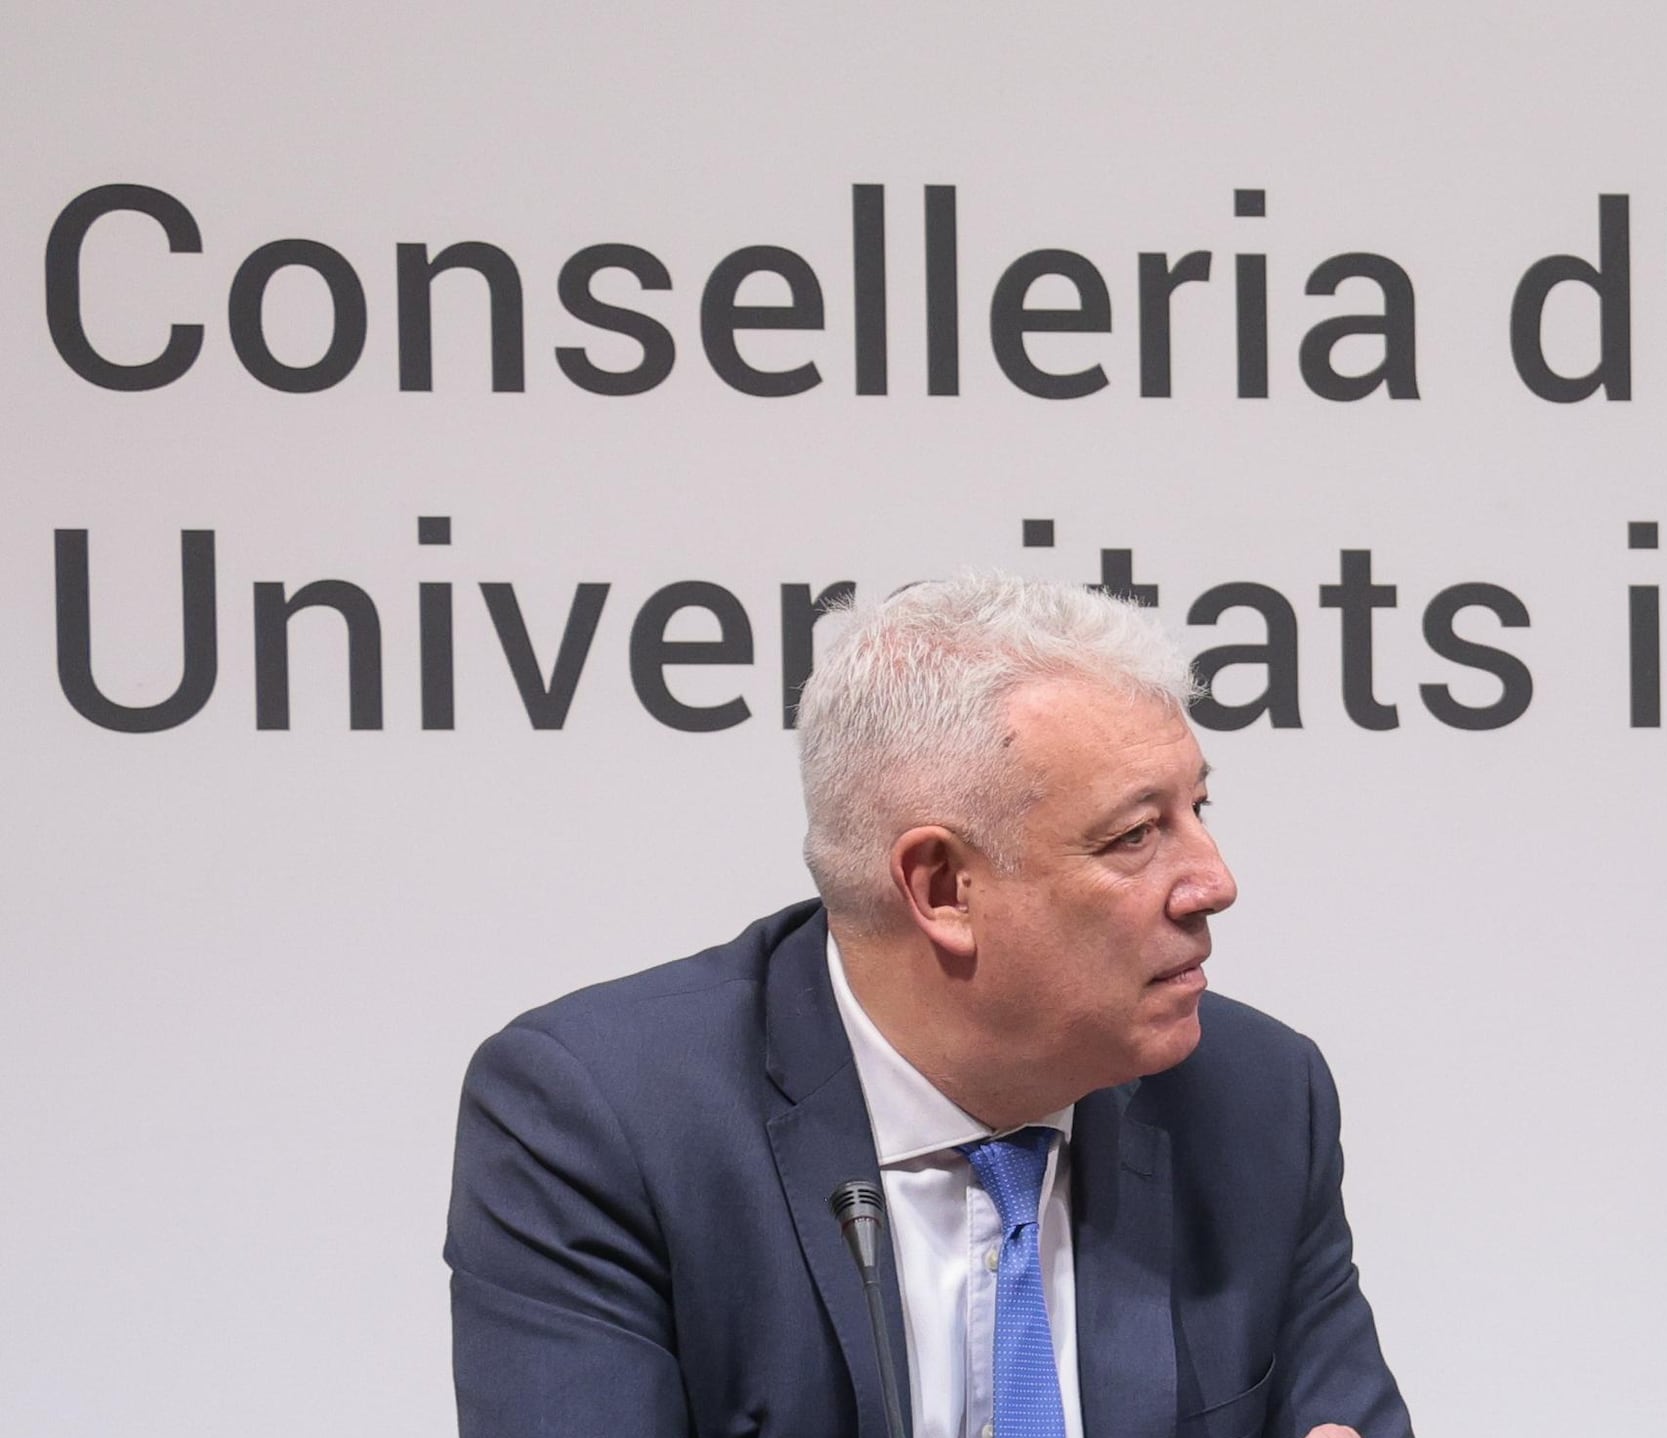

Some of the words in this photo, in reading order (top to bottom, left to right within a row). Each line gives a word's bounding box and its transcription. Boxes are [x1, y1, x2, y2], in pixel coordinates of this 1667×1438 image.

[43, 182, 1422, 404] Conselleria
[52, 515, 1535, 735] Univerats
[1628, 520, 1661, 729] i
